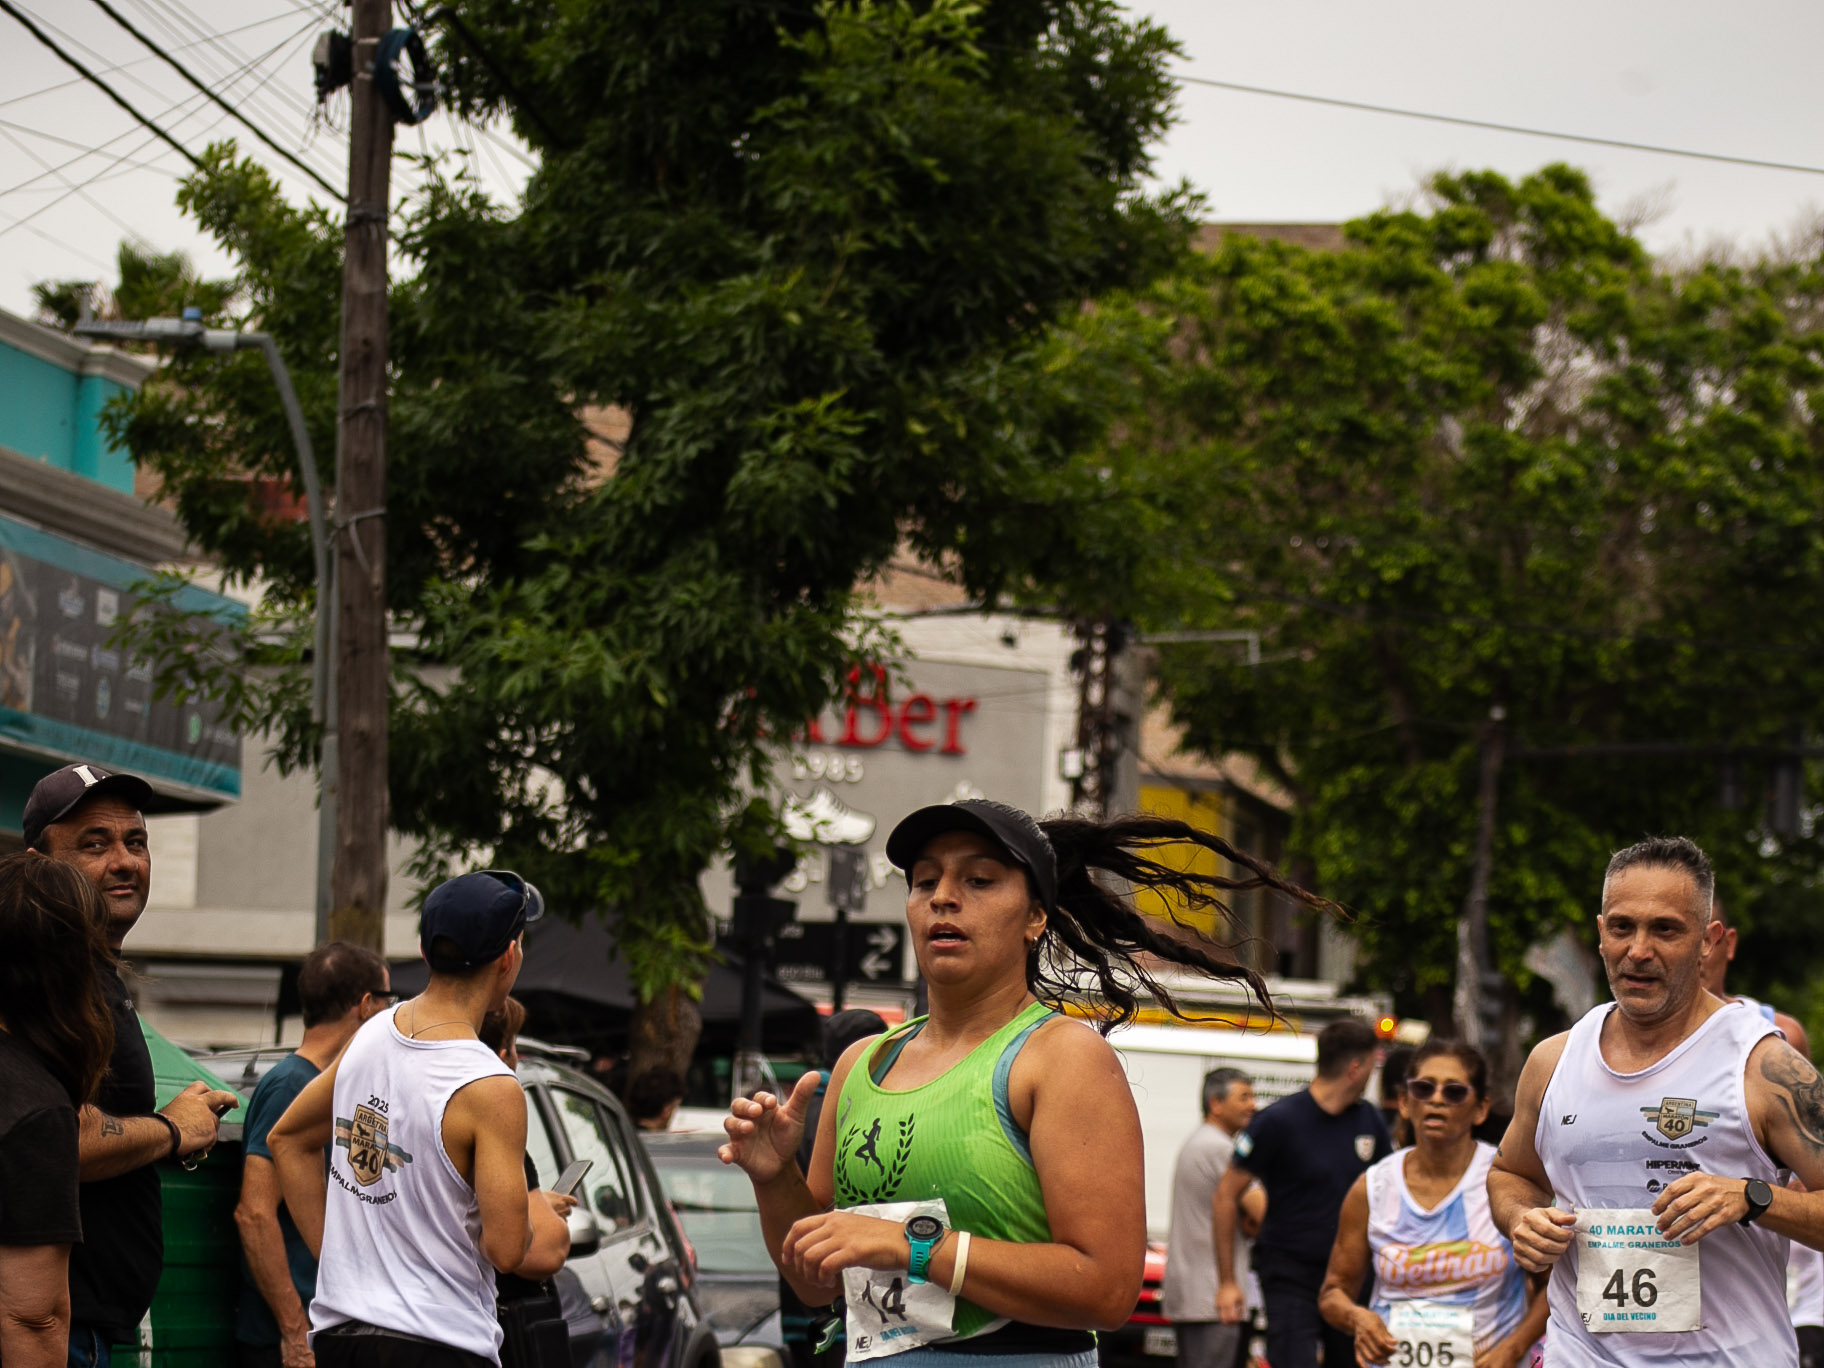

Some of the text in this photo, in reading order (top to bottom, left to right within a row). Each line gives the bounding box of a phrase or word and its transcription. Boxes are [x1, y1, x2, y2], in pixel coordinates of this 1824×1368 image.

[368, 1094, 389, 1113] 2025
[1663, 1119, 1686, 1132] 40
[352, 1148, 379, 1174] 40
[1589, 1225, 1603, 1236] 40
[1587, 1241, 1682, 1249] EMPALME GRANEROS
[1379, 1243, 1507, 1287] Beltrán
[1602, 1268, 1658, 1308] 46
[861, 1277, 908, 1324] 14
[1616, 1312, 1629, 1320] DEL
[1630, 1312, 1657, 1320] VECINO
[855, 1335, 873, 1350] NEJ
[1399, 1340, 1455, 1368] 305
